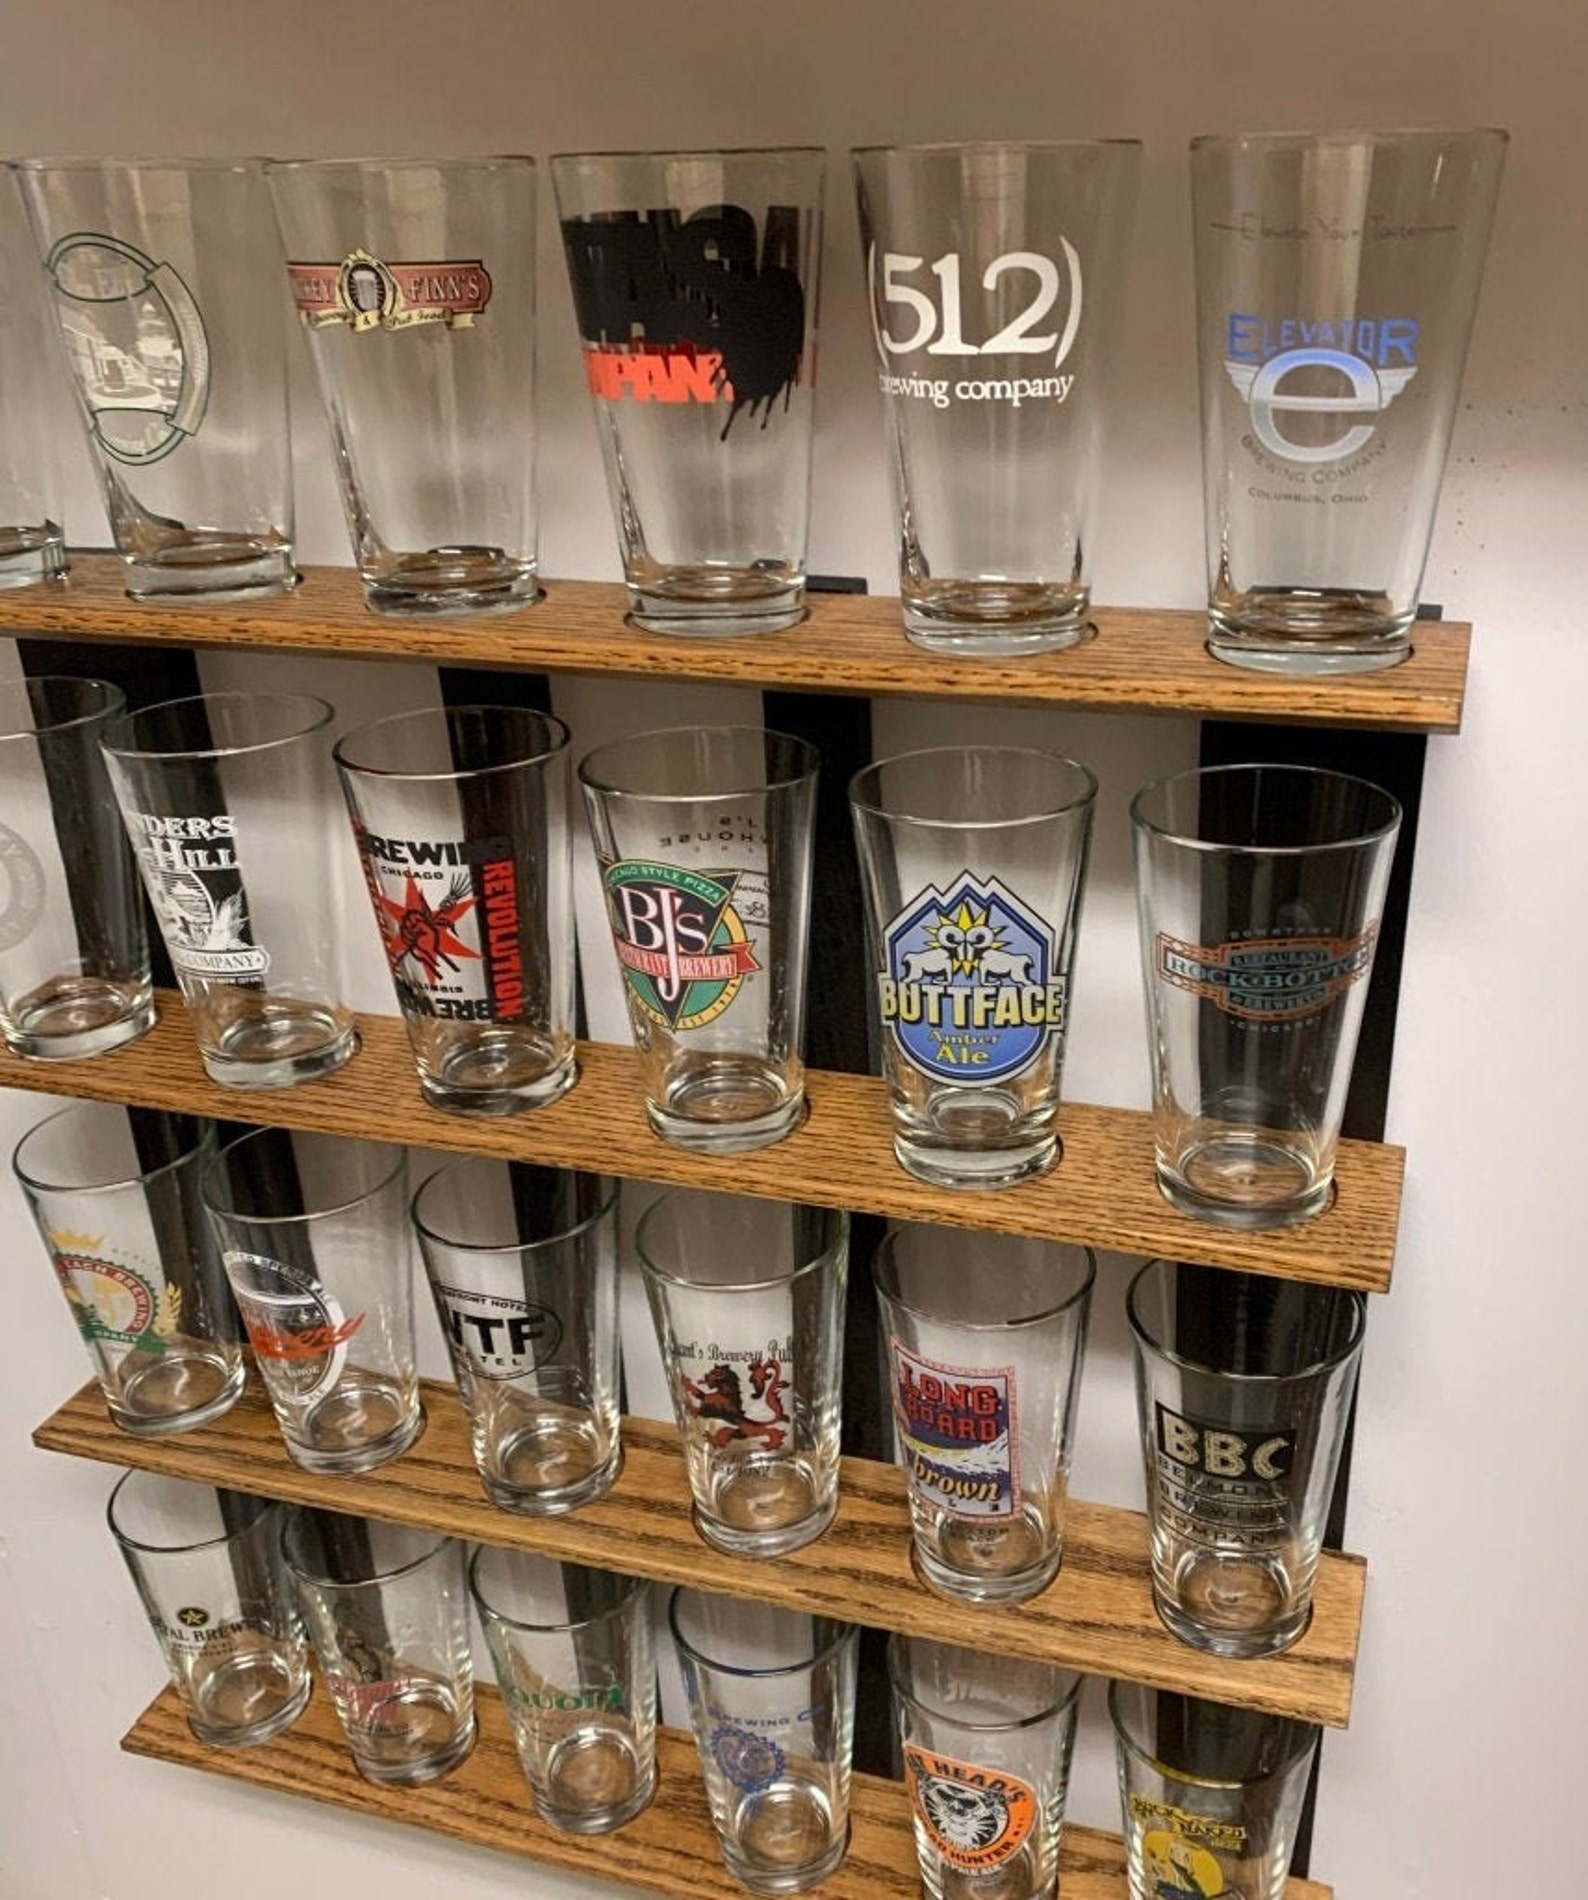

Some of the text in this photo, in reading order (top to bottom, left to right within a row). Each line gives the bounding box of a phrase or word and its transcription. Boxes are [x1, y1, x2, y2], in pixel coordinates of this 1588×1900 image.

[868, 235, 1082, 369] (512)
[955, 374, 1075, 407] company
[143, 815, 238, 841] DERS
[684, 877, 720, 901] PIZZA
[483, 859, 524, 1020] REVOLUTION
[880, 979, 1063, 1027] BUTTFACE
[935, 1044, 990, 1065] Ale
[480, 1355, 523, 1367] TEL
[901, 1360, 1000, 1418] LONG
[1161, 1408, 1291, 1481] BBC
[913, 1454, 1002, 1502] brown
